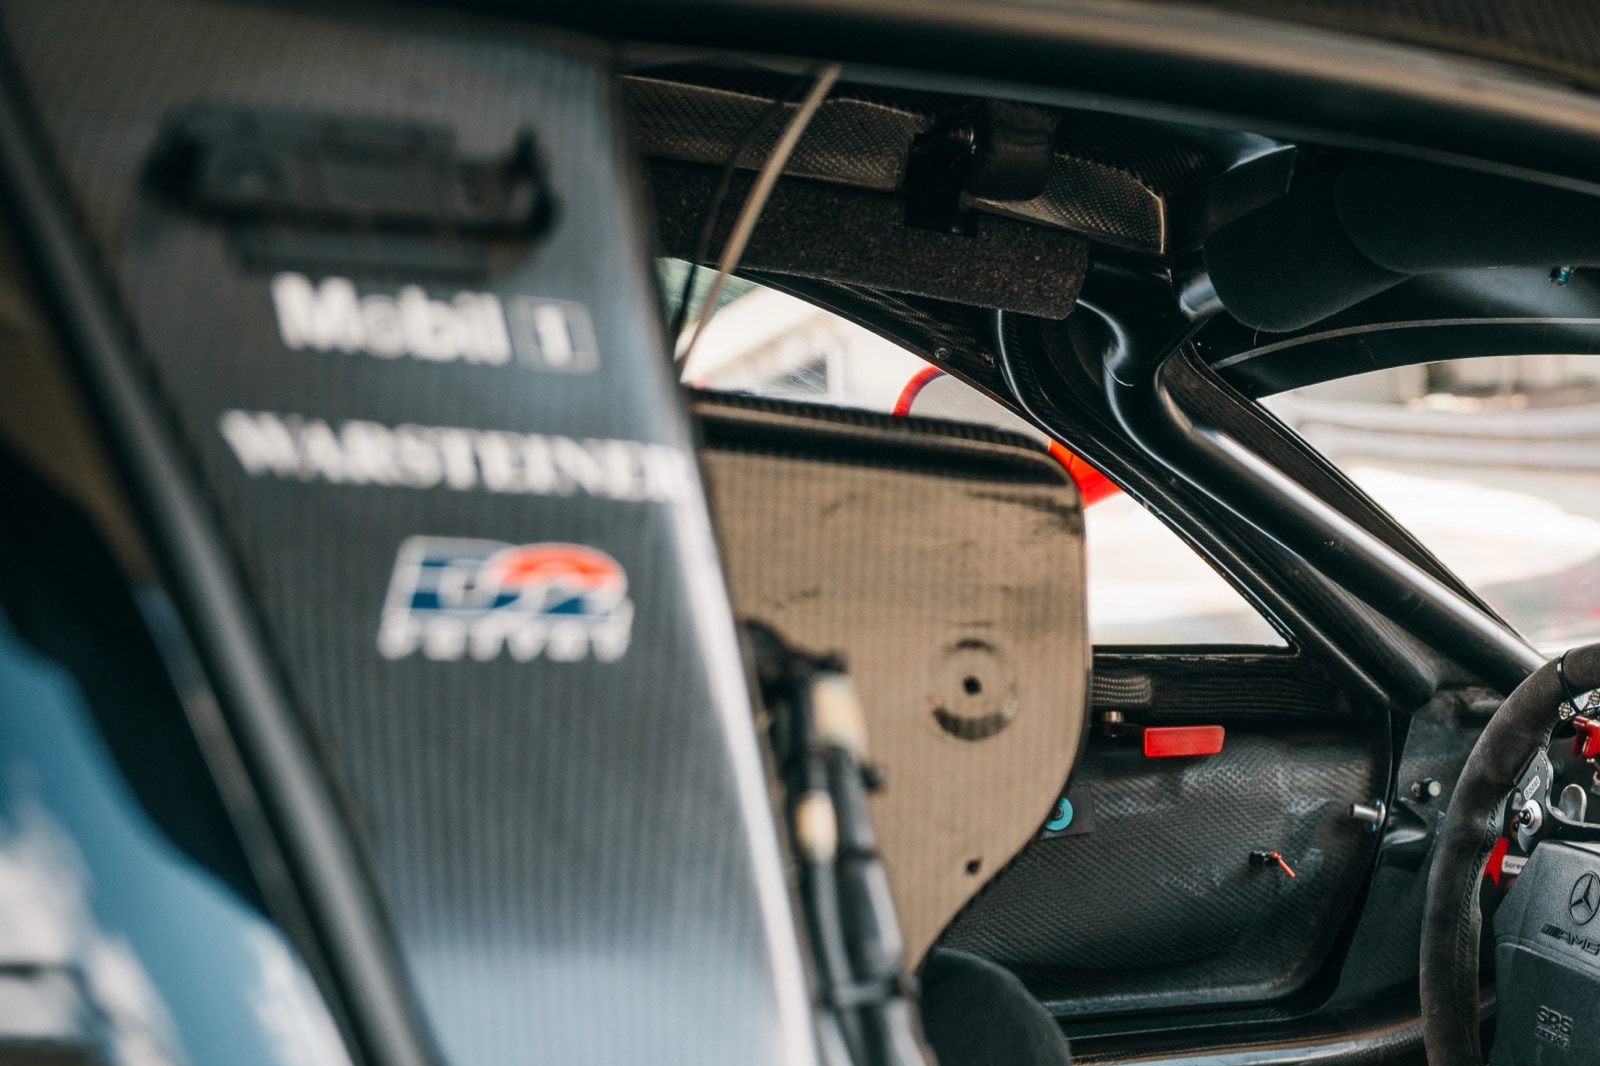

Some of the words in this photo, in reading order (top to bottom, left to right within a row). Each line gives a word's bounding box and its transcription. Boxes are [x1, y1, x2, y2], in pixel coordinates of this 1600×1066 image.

[271, 271, 511, 366] Mobil
[219, 408, 694, 502] WARSTEINER
[1524, 778, 1540, 799] Boost
[1557, 930, 1600, 956] AMG
[1537, 1005, 1573, 1036] SRS
